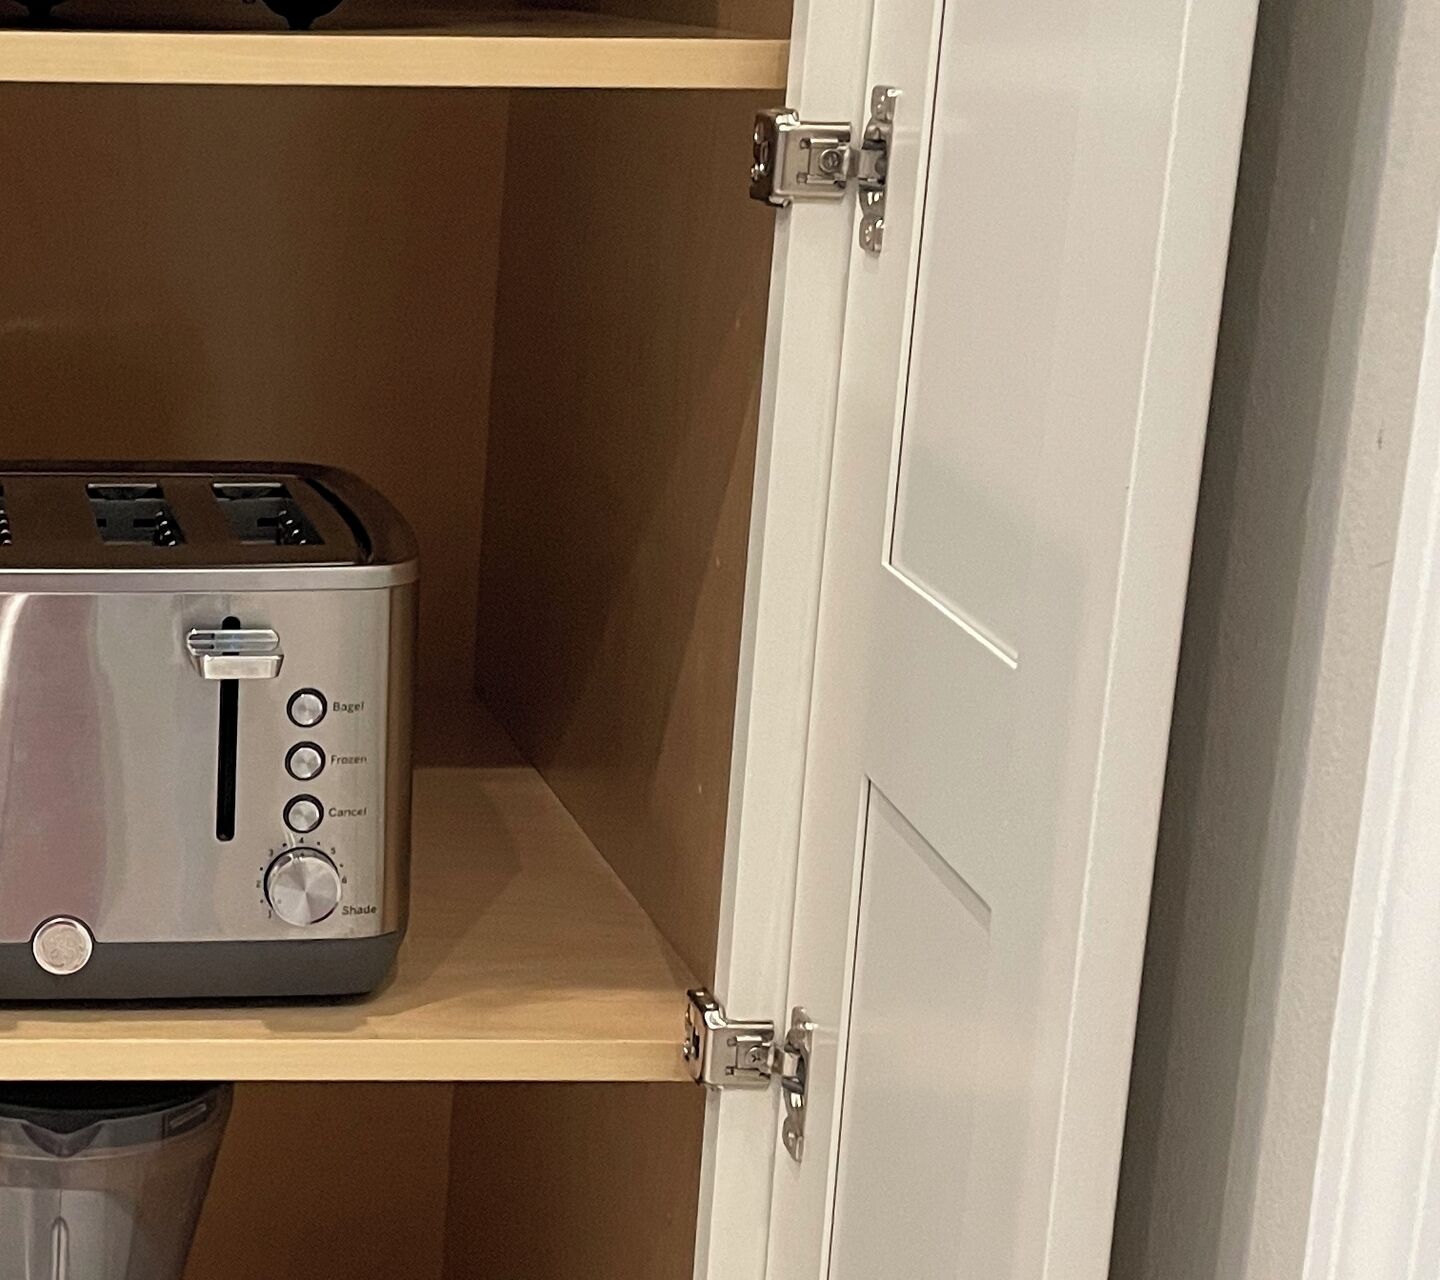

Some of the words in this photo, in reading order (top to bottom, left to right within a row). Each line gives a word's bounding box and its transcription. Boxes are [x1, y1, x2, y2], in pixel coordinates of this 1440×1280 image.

[333, 701, 365, 712] Bagel
[330, 755, 368, 766] Frozen
[328, 807, 368, 818] Cancel
[341, 905, 377, 917] Shade
